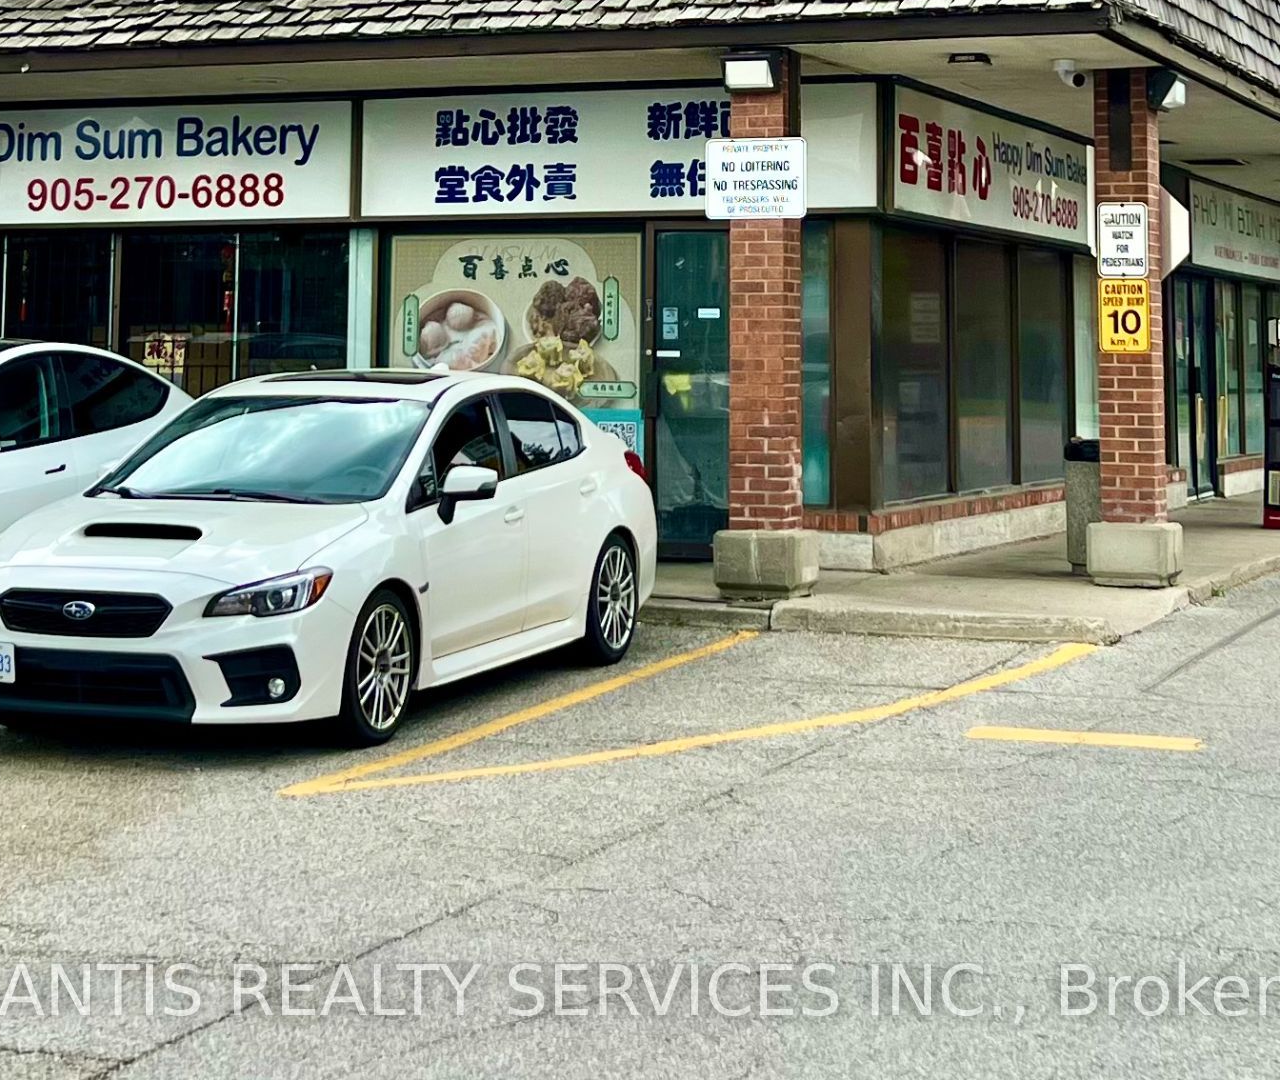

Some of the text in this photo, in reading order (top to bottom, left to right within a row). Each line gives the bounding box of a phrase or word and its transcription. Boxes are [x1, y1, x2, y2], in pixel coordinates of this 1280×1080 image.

[74, 119, 163, 160] Sum
[175, 115, 320, 166] Bakery
[753, 144, 788, 152] PROPERTY
[992, 131, 1022, 176] Happy
[1026, 141, 1043, 171] Dim
[1044, 147, 1065, 177] Sum
[722, 160, 790, 172] NO LOITERING
[435, 163, 577, 203] 堂食外賣
[733, 179, 798, 191] TRESPASSING
[27, 173, 284, 211] 905-270-6888
[1012, 185, 1078, 230] 905-270-6888
[1112, 231, 1133, 239] WATCH
[1116, 244, 1129, 253] FOR
[458, 255, 569, 280] 百喜点心
[1102, 257, 1144, 267] PEDESTRIANS
[1105, 284, 1142, 295] CAUTION
[1103, 297, 1123, 306] SPEED
[1107, 309, 1141, 334] 10
